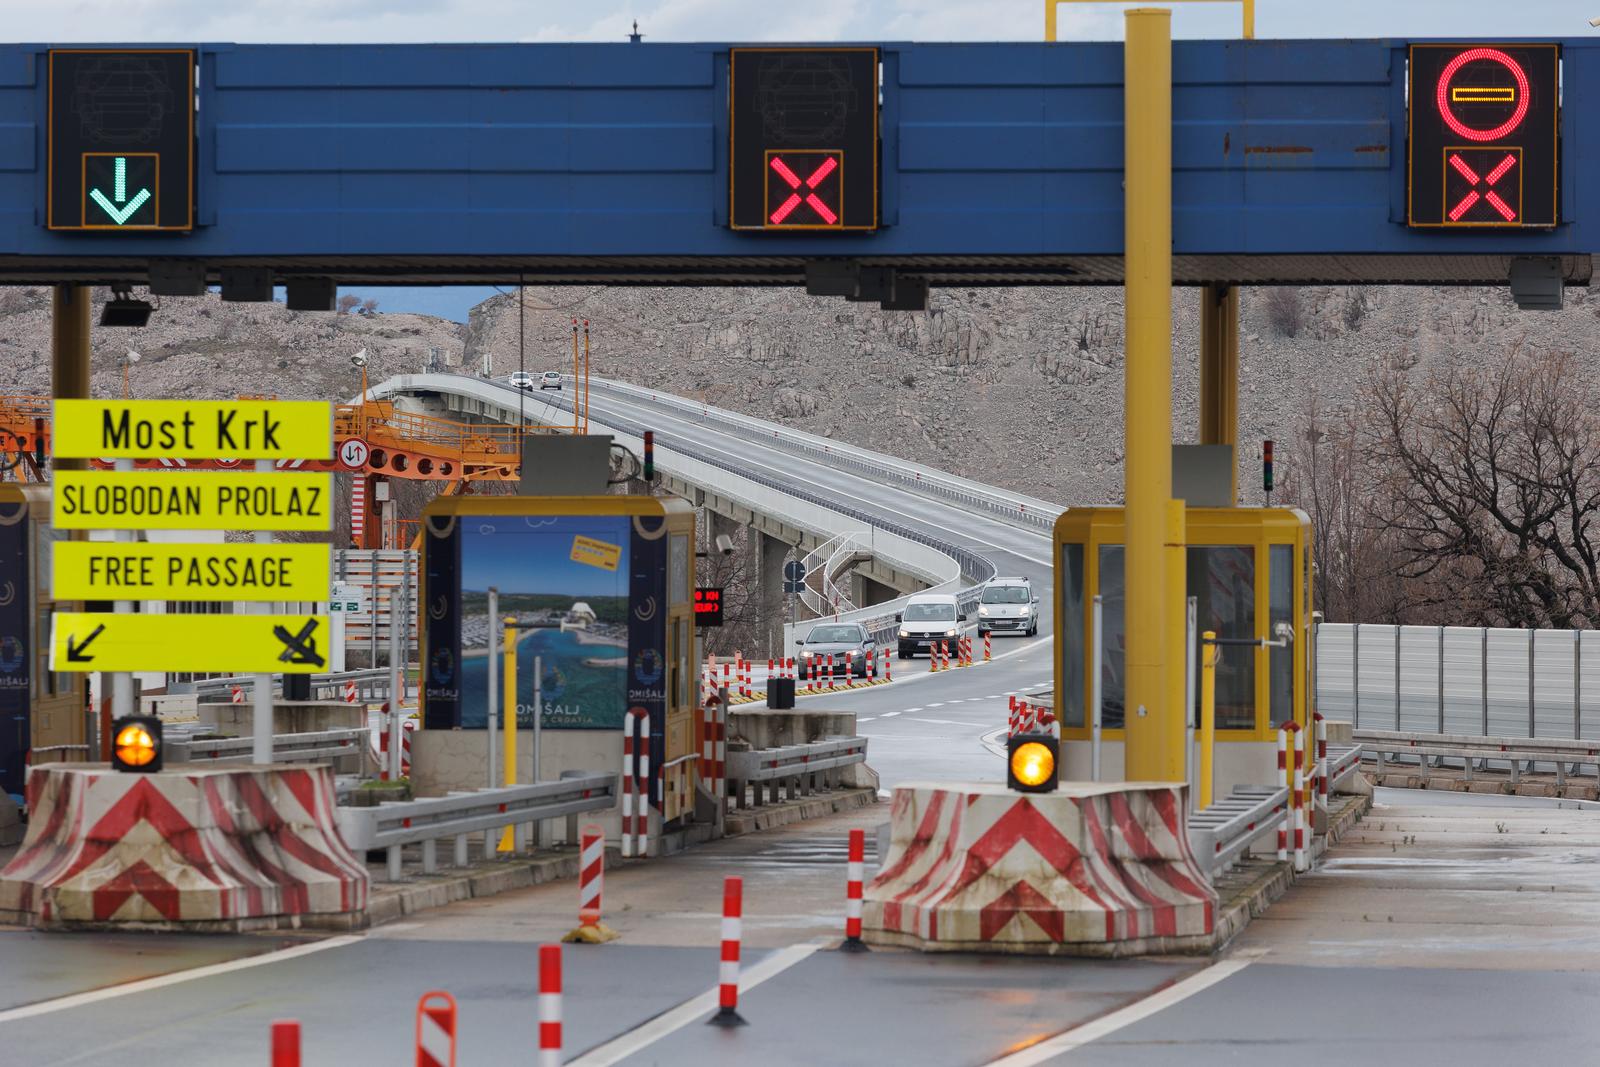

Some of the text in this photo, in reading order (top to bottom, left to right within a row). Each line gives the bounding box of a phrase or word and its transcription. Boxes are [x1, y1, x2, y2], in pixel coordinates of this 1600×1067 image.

[103, 409, 281, 450] Most Krk
[62, 485, 322, 517] SLOBODAN PROLAZ
[89, 556, 293, 587] FREE PASSAGE
